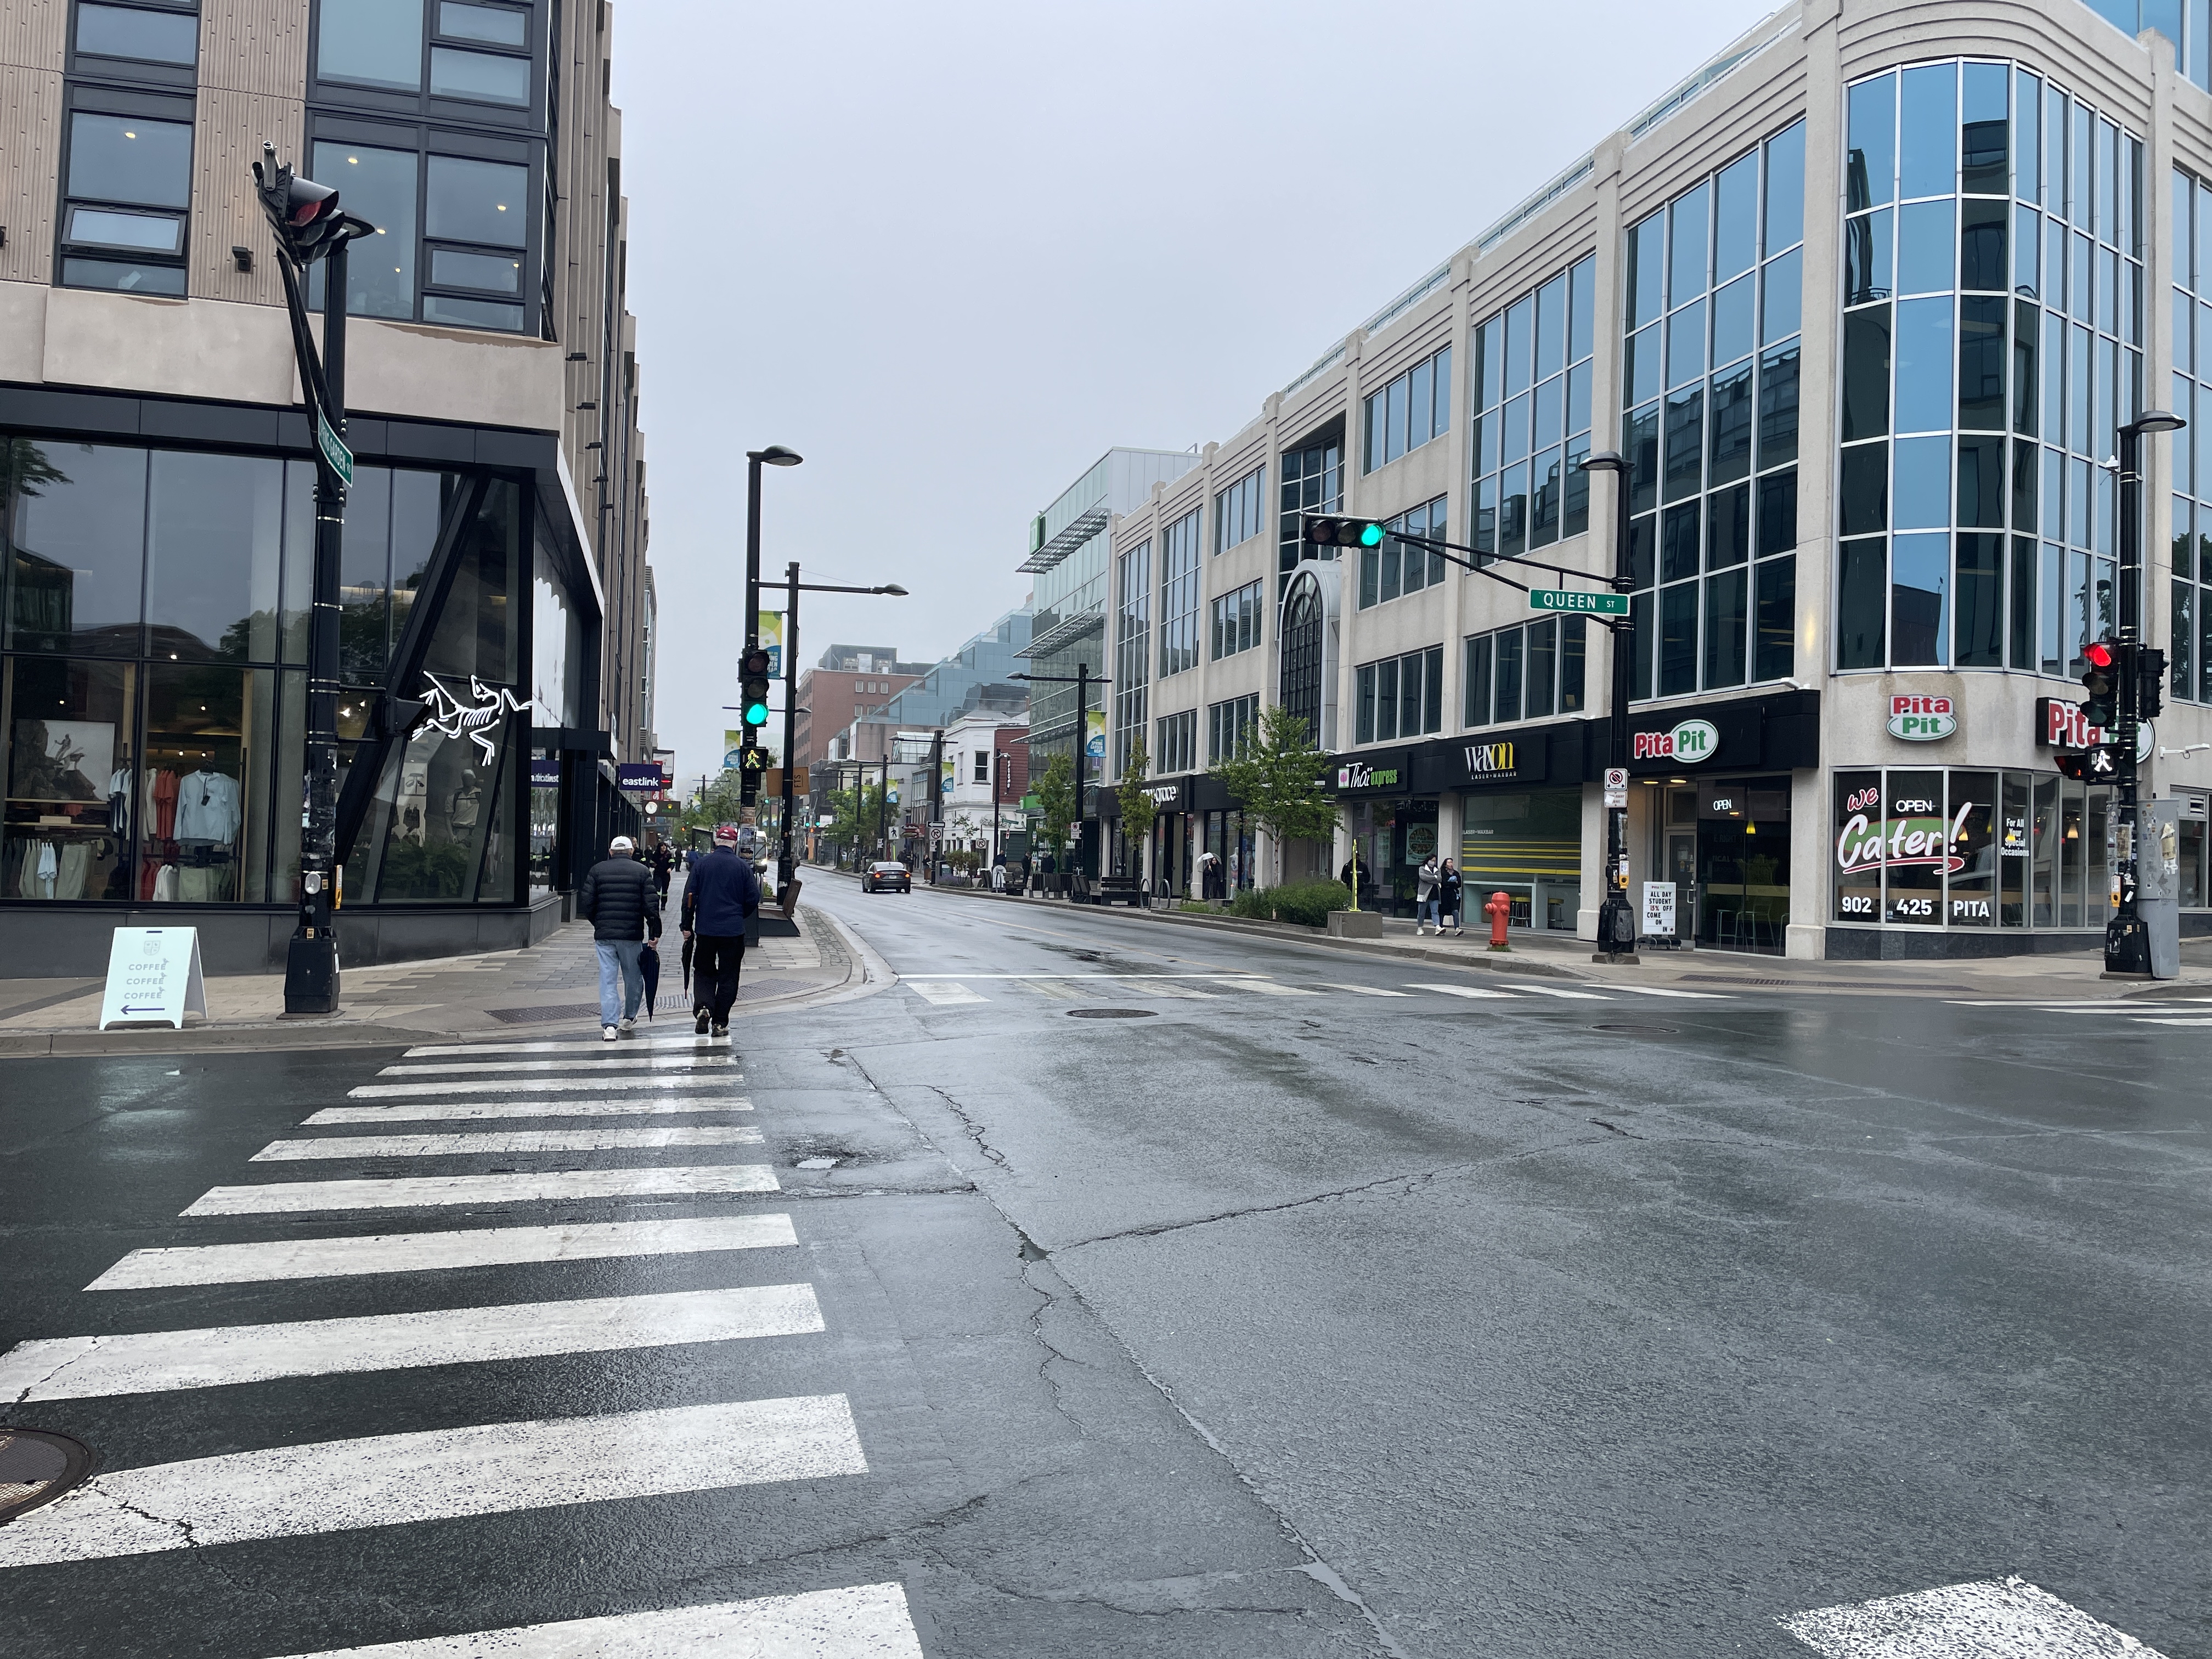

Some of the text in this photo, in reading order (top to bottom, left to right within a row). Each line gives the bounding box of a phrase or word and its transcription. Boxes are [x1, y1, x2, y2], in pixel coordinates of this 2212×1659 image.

[1543, 592, 1596, 609] QUEEN
[1893, 697, 1950, 714] Pita
[1903, 717, 1941, 734] Pit
[2049, 703, 2101, 747] Pita
[1635, 730, 1707, 757] Pita Pit
[622, 776, 659, 787] eastlink
[1370, 769, 1398, 788] express
[1713, 799, 1732, 811] OPEN
[1895, 800, 1933, 812] OPEN
[2006, 817, 2024, 828] For All
[1838, 802, 1972, 868] Cater!
[2009, 828, 2022, 837] Your
[2005, 838, 2026, 848] Special
[2001, 847, 2030, 857] Occasions
[1841, 896, 1990, 918] 902 425 PITA
